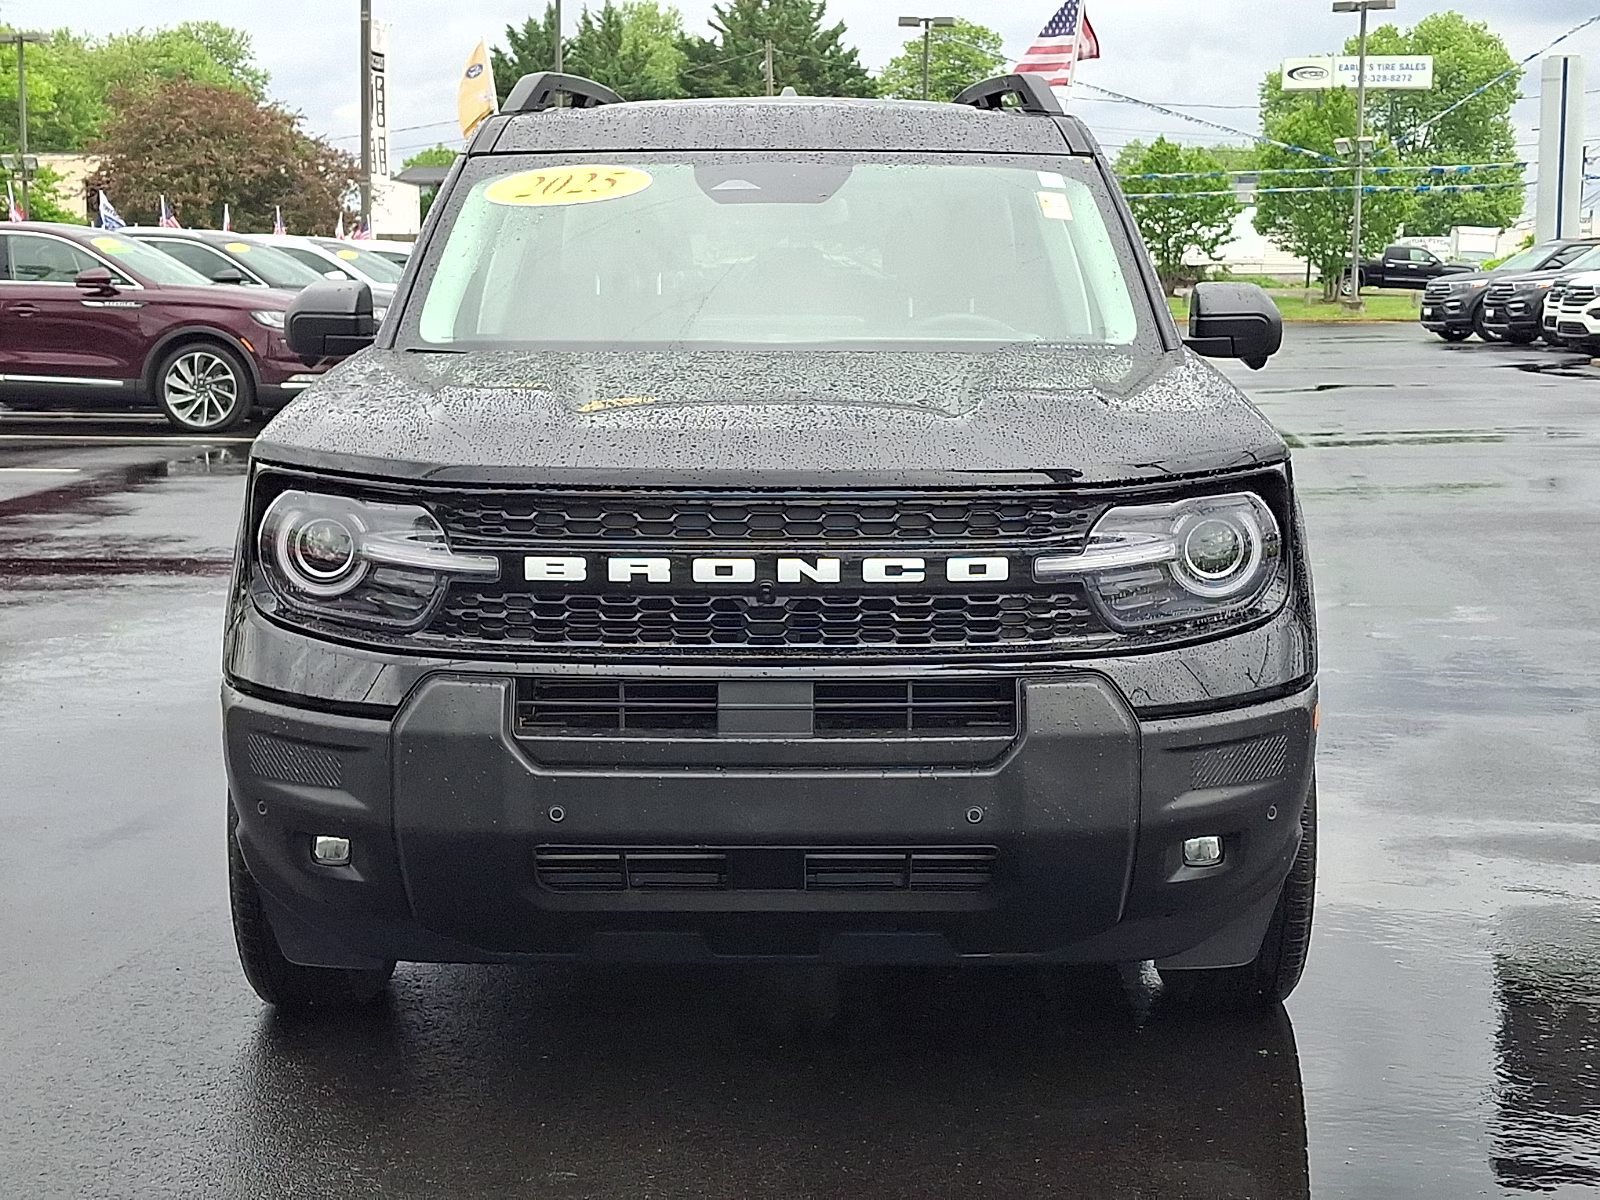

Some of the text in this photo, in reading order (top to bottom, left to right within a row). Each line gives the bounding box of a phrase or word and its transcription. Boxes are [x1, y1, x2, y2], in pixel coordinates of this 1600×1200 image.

[1377, 63, 1396, 71] TIRE
[1399, 62, 1426, 71] SALES
[513, 171, 627, 199] 2025
[524, 556, 1009, 584] BRONCO
